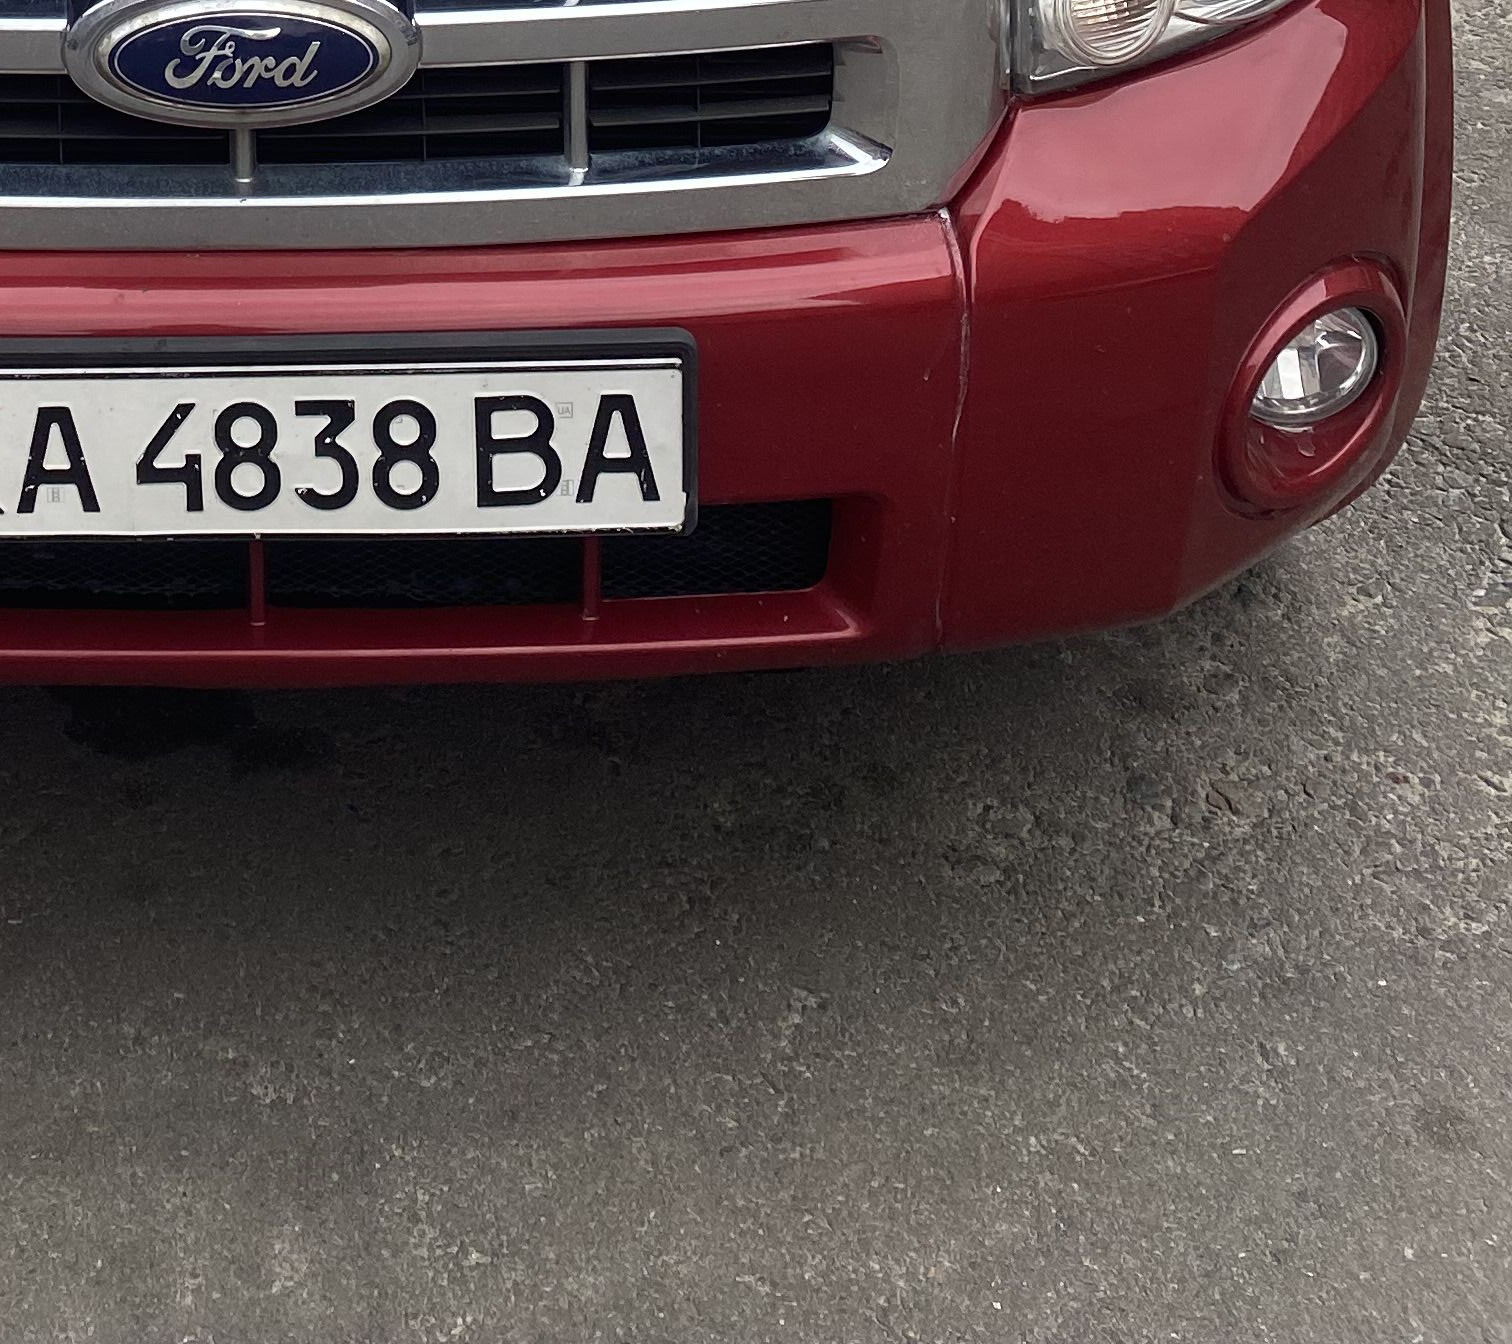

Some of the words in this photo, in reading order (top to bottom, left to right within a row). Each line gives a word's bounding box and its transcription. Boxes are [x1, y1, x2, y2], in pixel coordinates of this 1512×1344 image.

[164, 24, 321, 90] Ford
[136, 398, 439, 512] 4838
[474, 394, 661, 509] BA
